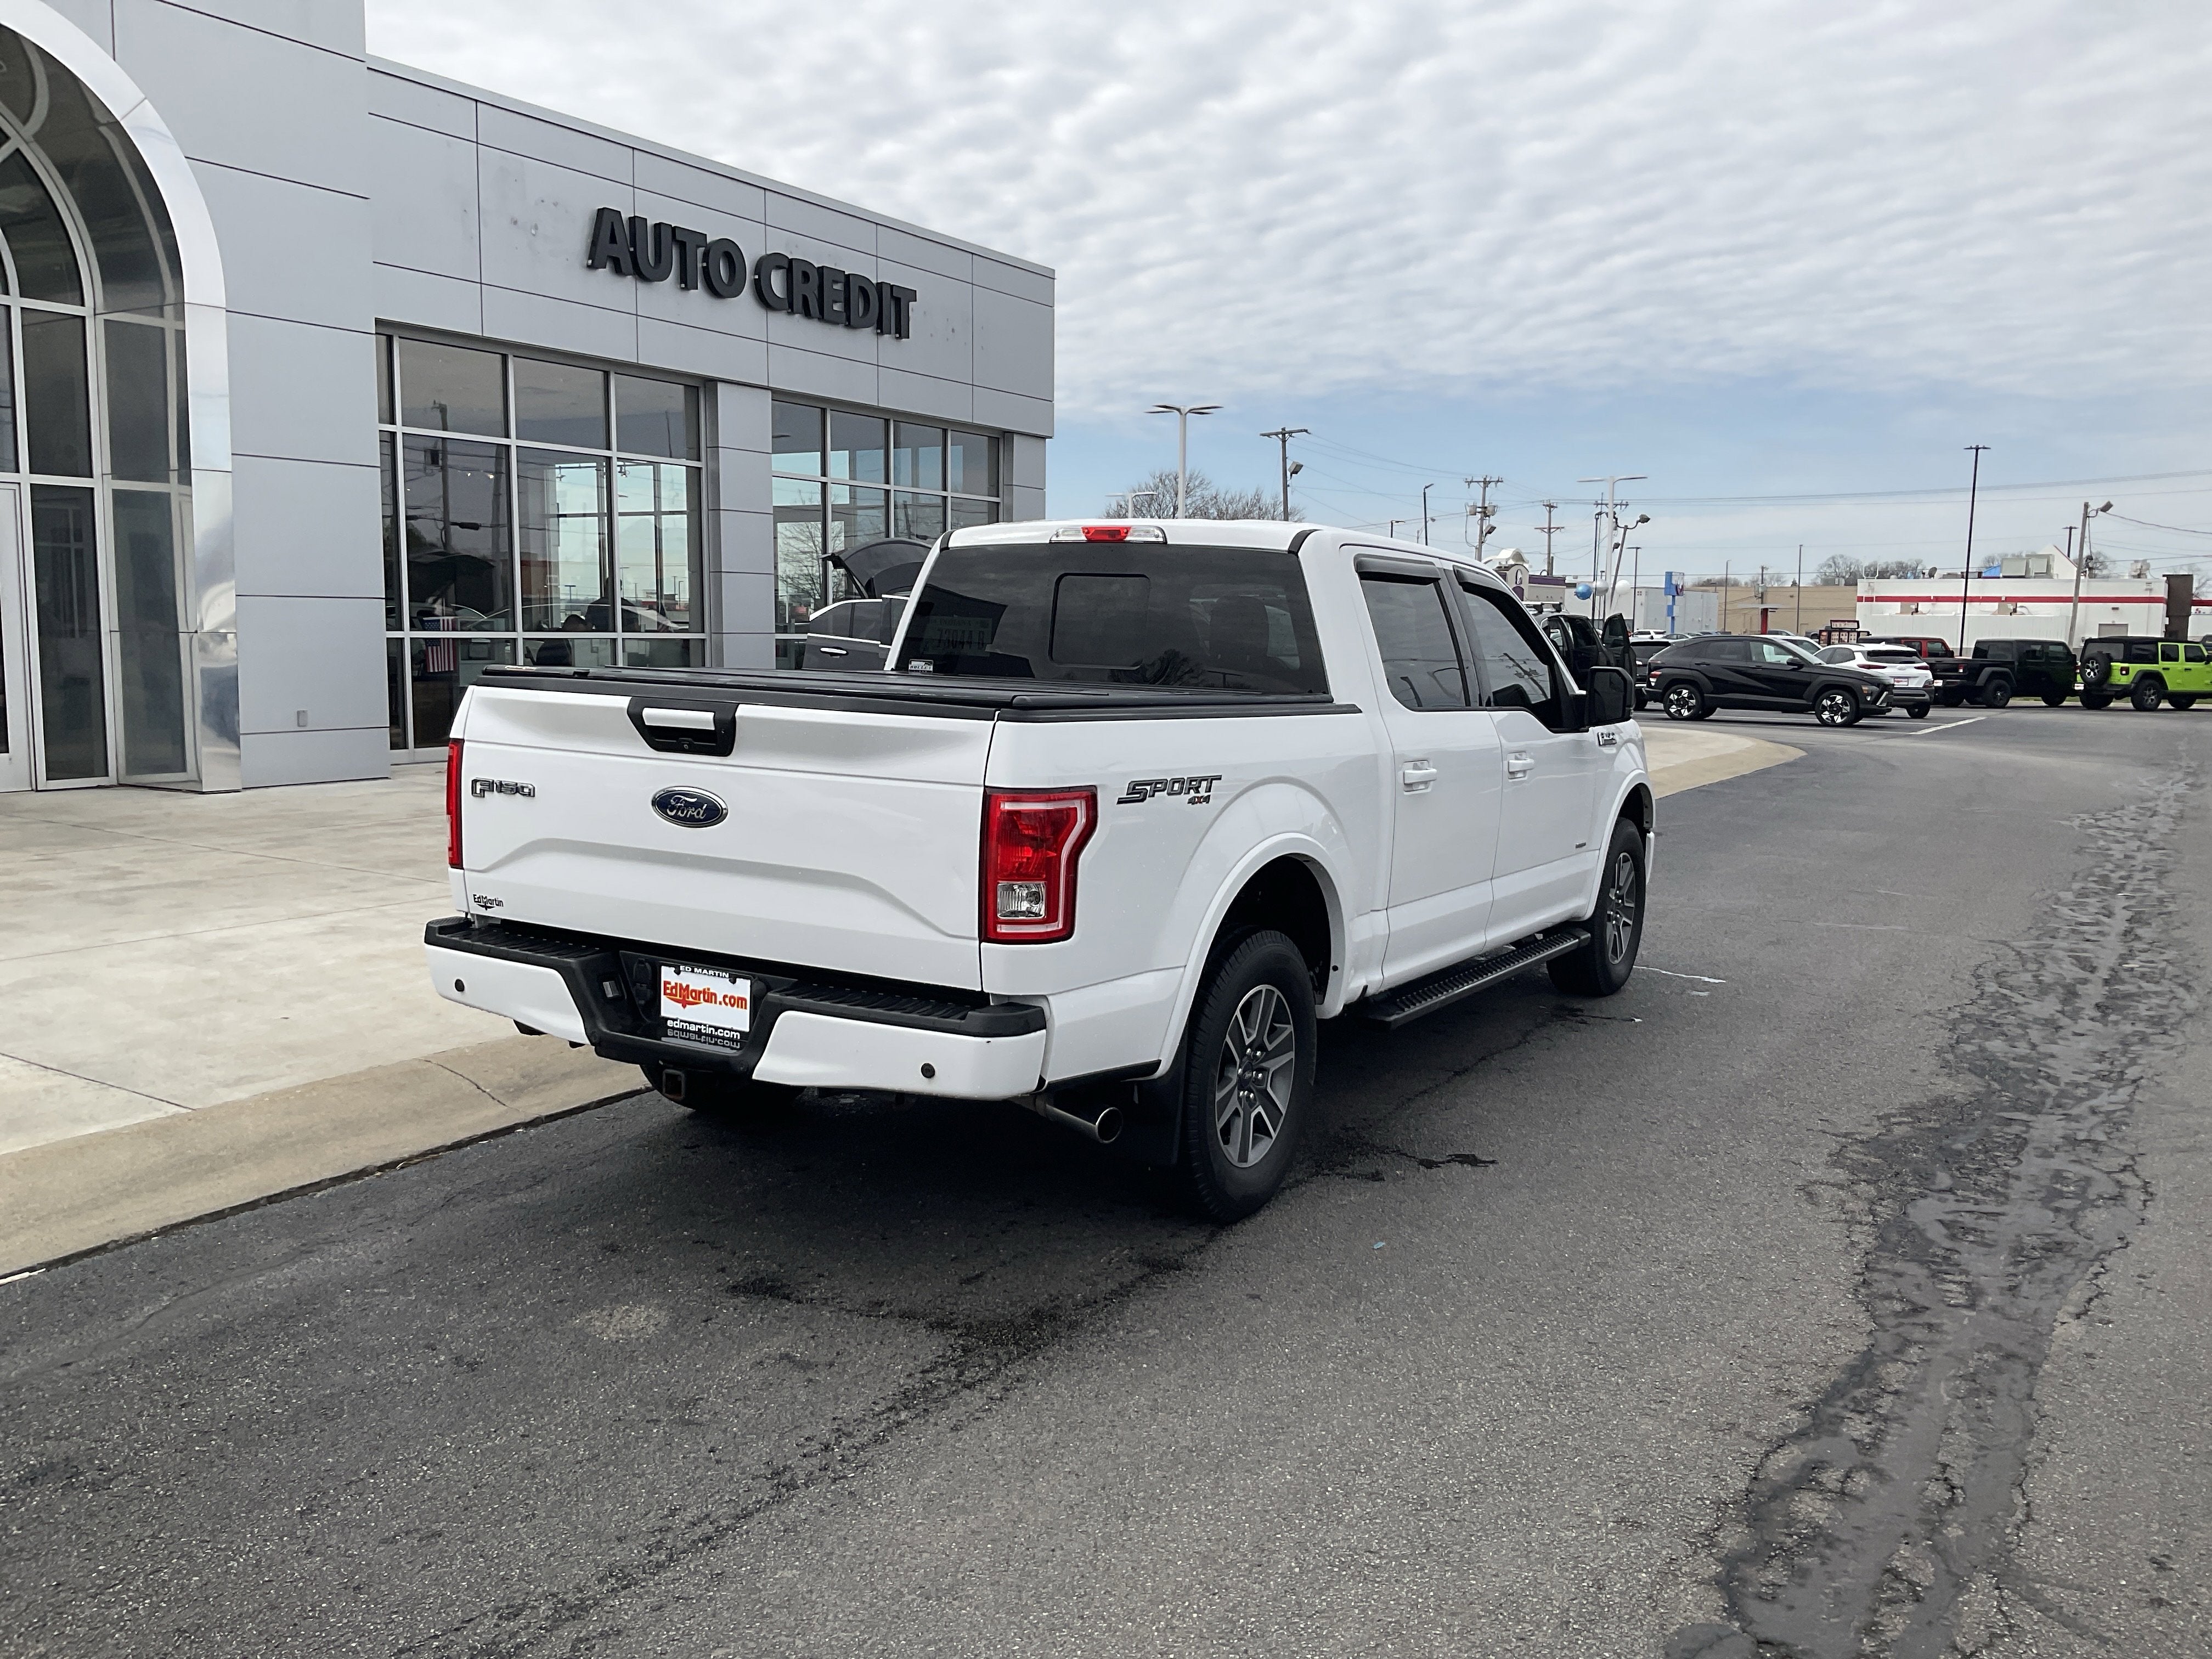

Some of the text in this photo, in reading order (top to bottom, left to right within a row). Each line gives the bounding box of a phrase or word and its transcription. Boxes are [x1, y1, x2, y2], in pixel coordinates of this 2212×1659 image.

[586, 207, 917, 339] AUTO CREDIT
[1116, 775, 1222, 805] SPORT
[667, 795, 708, 819] Ford
[694, 968, 729, 978] MARTIN
[667, 1019, 740, 1039] edmartin.com
